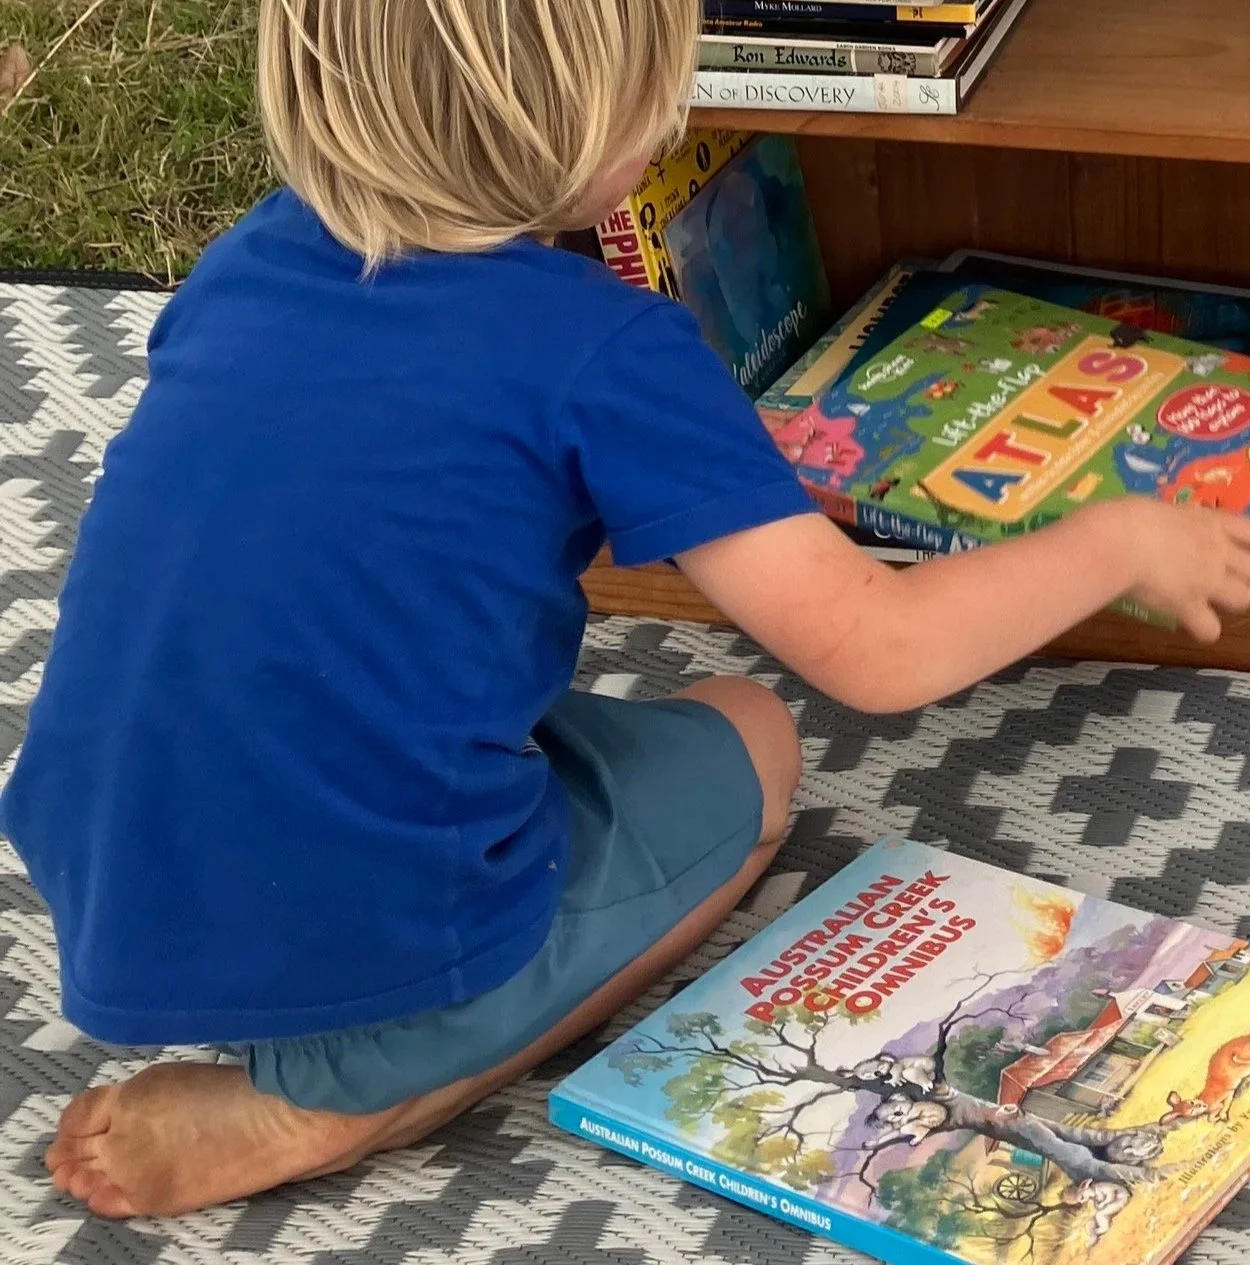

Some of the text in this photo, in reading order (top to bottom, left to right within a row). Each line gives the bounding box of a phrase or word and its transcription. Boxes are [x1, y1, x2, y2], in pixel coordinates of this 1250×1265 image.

[732, 45, 848, 68] Ron Edwards
[754, 0, 823, 13] MYKE MOLLARD
[719, 88, 739, 100] OF
[745, 86, 856, 108] DISCOVERY
[952, 351, 1148, 505] ATLAS
[740, 874, 904, 998] AUSTRALIAN
[744, 870, 951, 1023] POSSUM CREEK
[803, 897, 956, 1012] CHILDREN'S
[845, 915, 976, 1014] OMNIBUS
[580, 1117, 832, 1230] AUSTRALIAN POSSUM CREEK CHILDREN'S OMNIBUS
[1178, 1132, 1231, 1186] Illustrations
